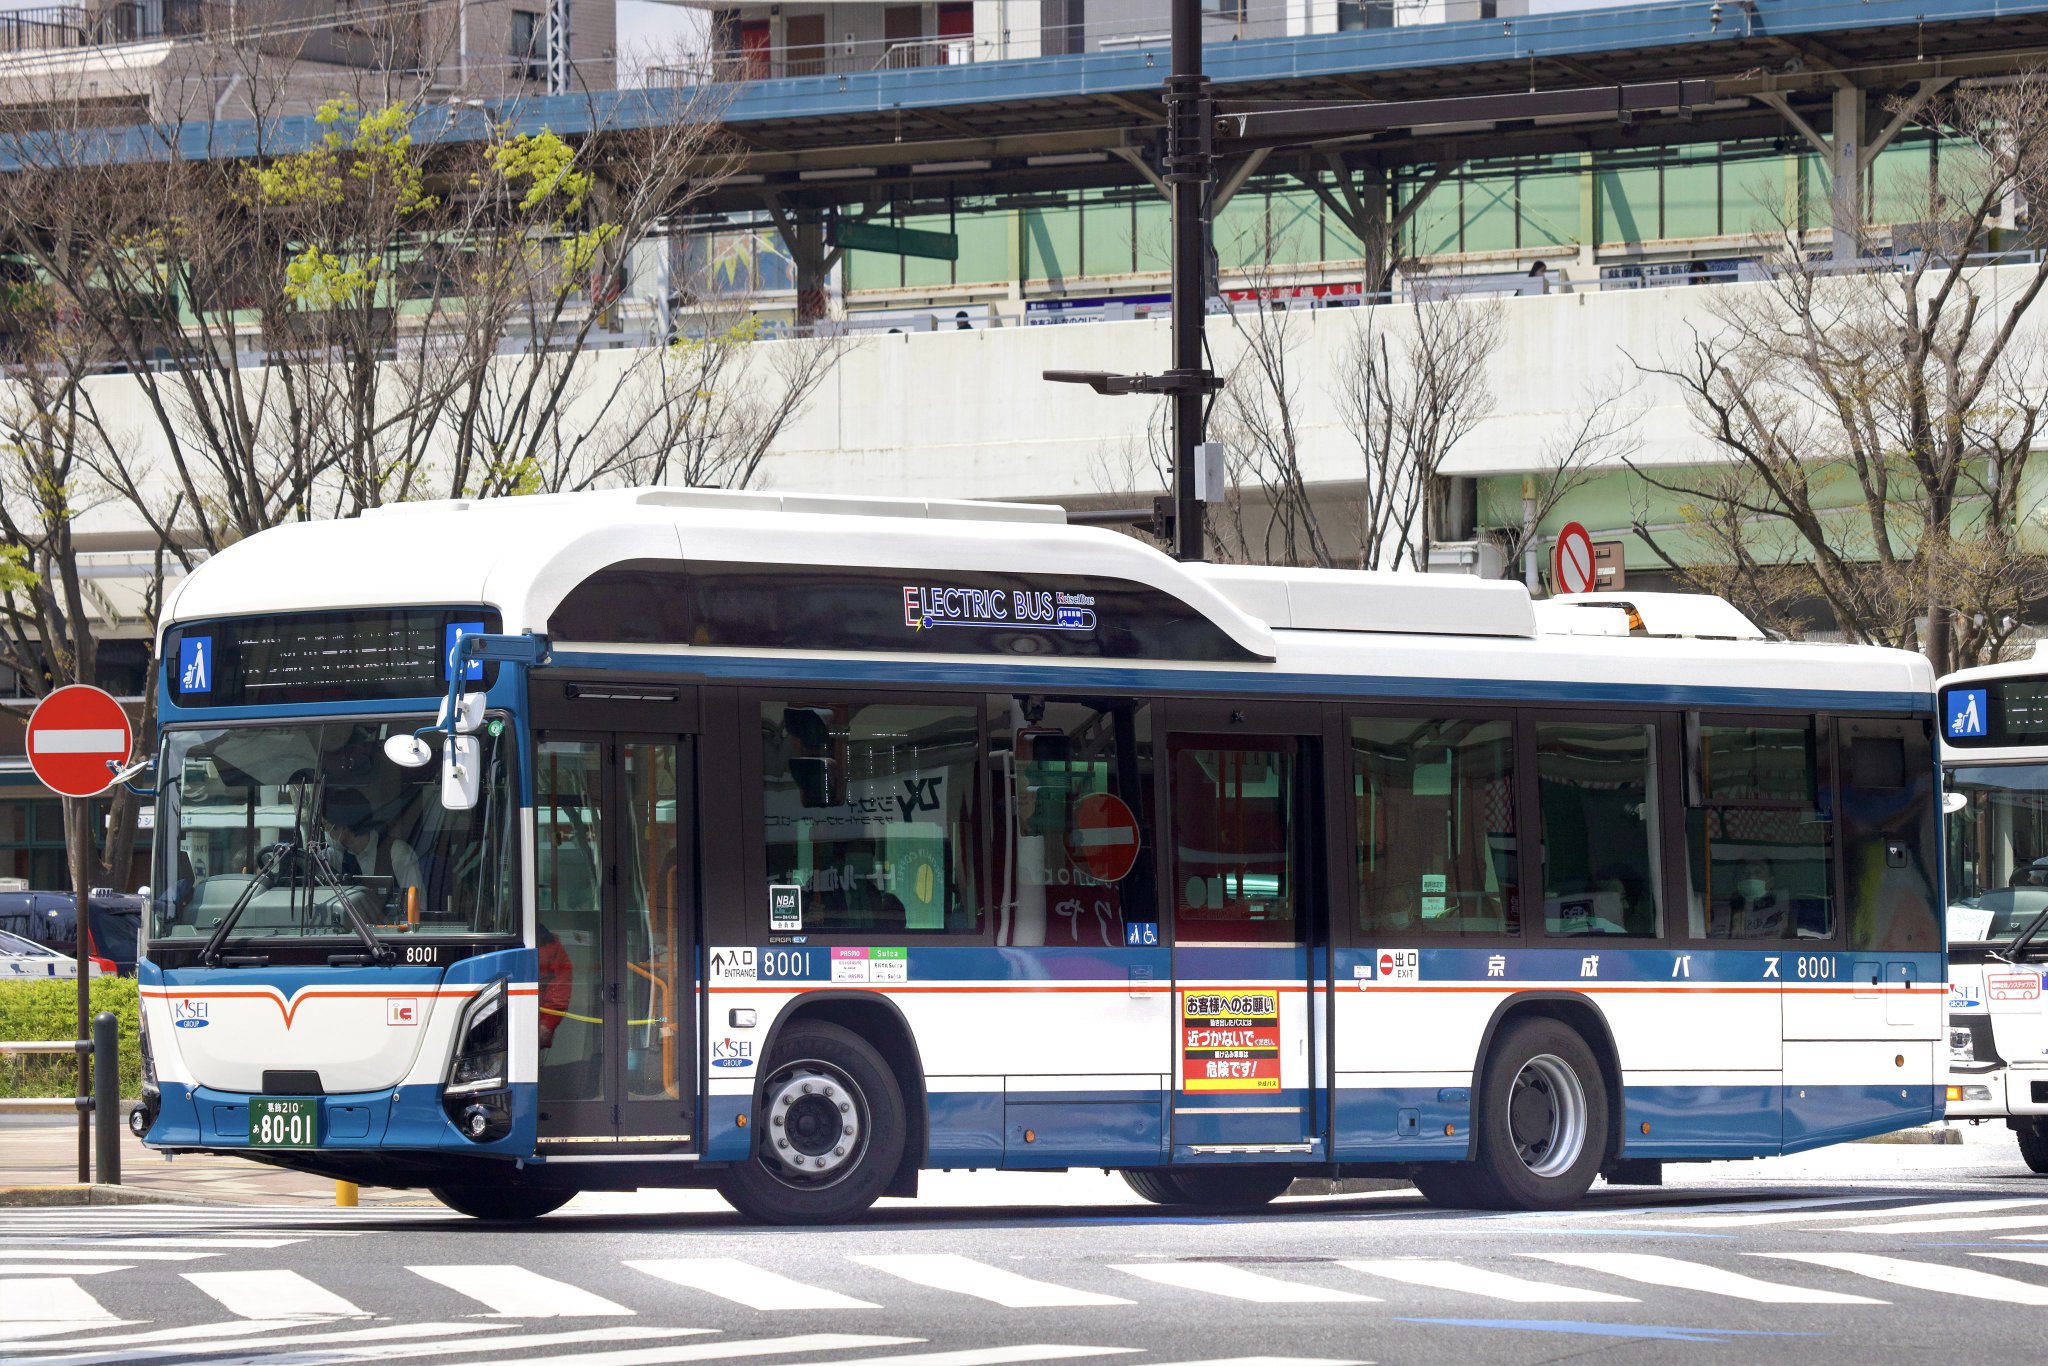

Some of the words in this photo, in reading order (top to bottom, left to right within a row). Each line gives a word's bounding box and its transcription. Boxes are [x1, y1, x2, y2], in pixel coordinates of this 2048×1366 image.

[903, 586, 1007, 626] ELECTRIC
[1013, 590, 1054, 620] BUS
[776, 895, 795, 906] NBA
[406, 947, 438, 963] 8001
[728, 951, 753, 966] 入口
[1395, 952, 1416, 967] 出口
[764, 952, 810, 976] 8001
[1797, 956, 1836, 979] 8001
[724, 968, 756, 978] ENTRANCE
[1397, 969, 1414, 978] EXIT
[1186, 995, 1275, 1014] お客様へのお願い
[253, 1125, 260, 1134] あ
